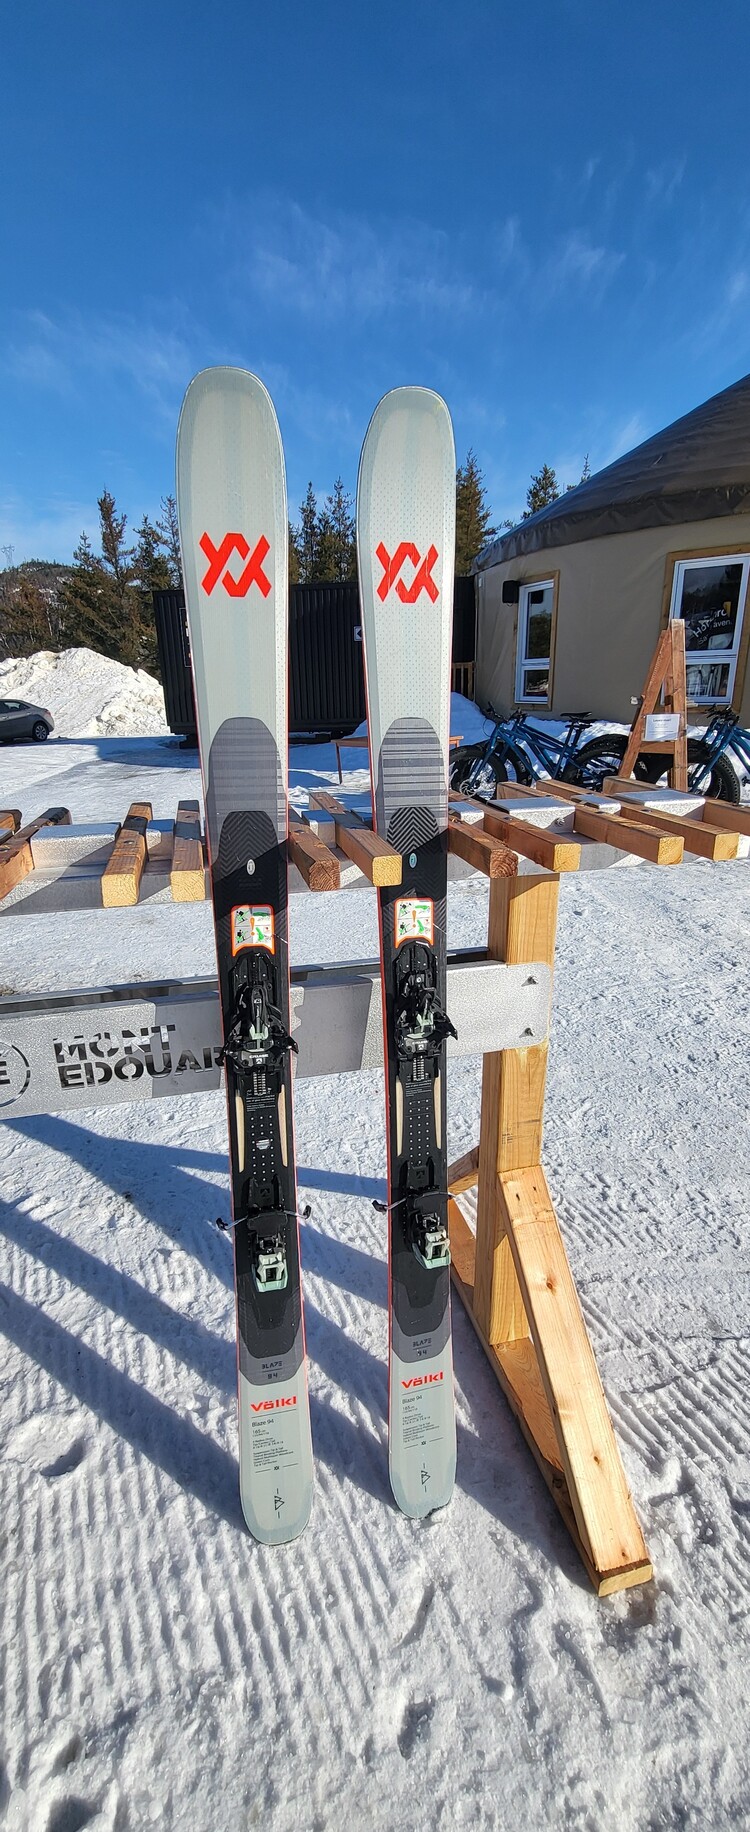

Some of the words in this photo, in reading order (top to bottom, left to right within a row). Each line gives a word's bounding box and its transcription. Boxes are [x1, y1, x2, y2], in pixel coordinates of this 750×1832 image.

[53, 1024, 176, 1063] MONT
[58, 1046, 225, 1090] EDOUAR
[401, 1371, 444, 1389] Völkl
[250, 1395, 297, 1412] Völkl
[251, 1420, 266, 1428] Blaze
